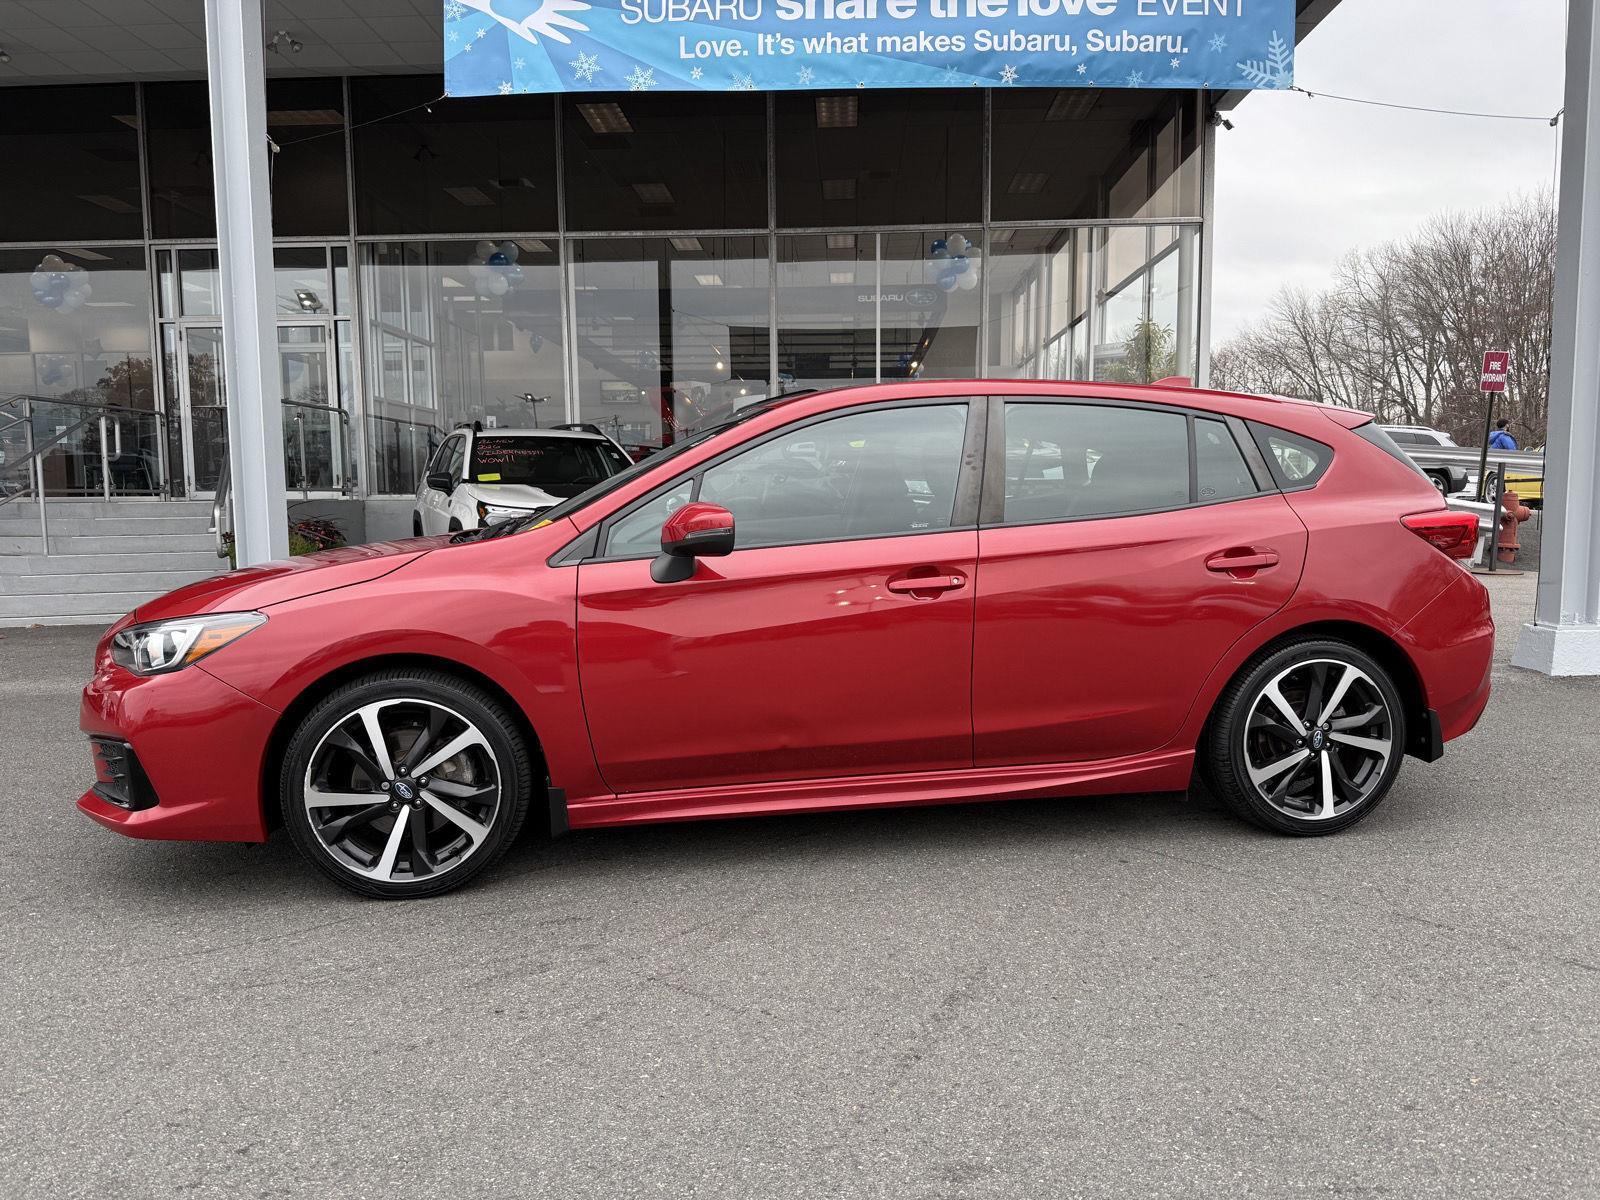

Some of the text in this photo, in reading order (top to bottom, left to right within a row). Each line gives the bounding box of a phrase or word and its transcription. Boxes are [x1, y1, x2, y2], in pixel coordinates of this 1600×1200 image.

[620, 0, 762, 25] SUBARU
[679, 28, 1189, 59] Love. It's what makes Subaru, Subaru.
